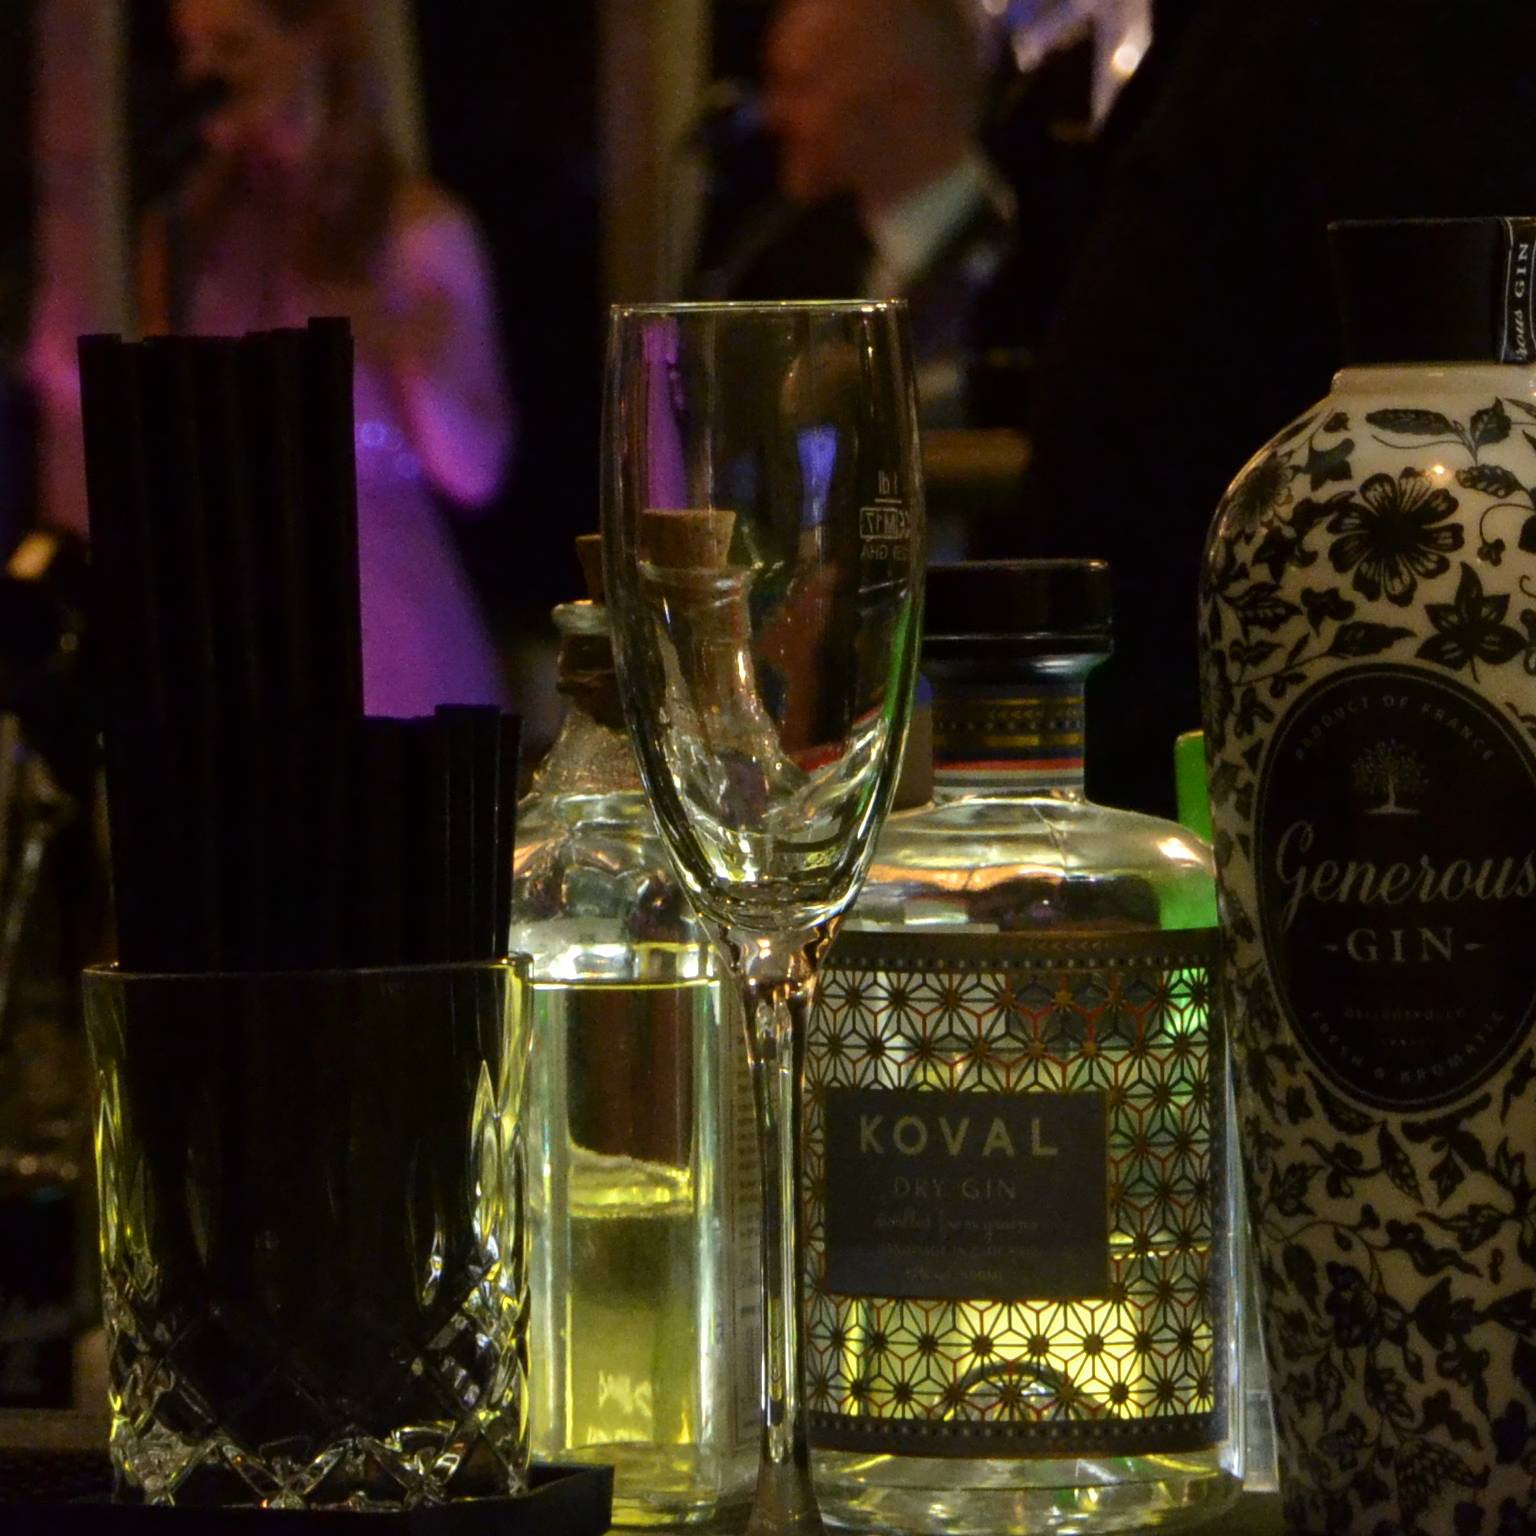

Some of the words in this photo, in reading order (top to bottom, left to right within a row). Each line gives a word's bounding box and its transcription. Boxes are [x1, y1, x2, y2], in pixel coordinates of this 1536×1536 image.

[1513, 243, 1530, 300] GIN
[1381, 694, 1410, 709] OF
[1420, 702, 1495, 762] FRANCE
[1275, 818, 1536, 935] Generous
[859, 1114, 1059, 1157] KOVAL
[893, 1175, 945, 1199] DRY
[961, 1176, 1017, 1200] GIN
